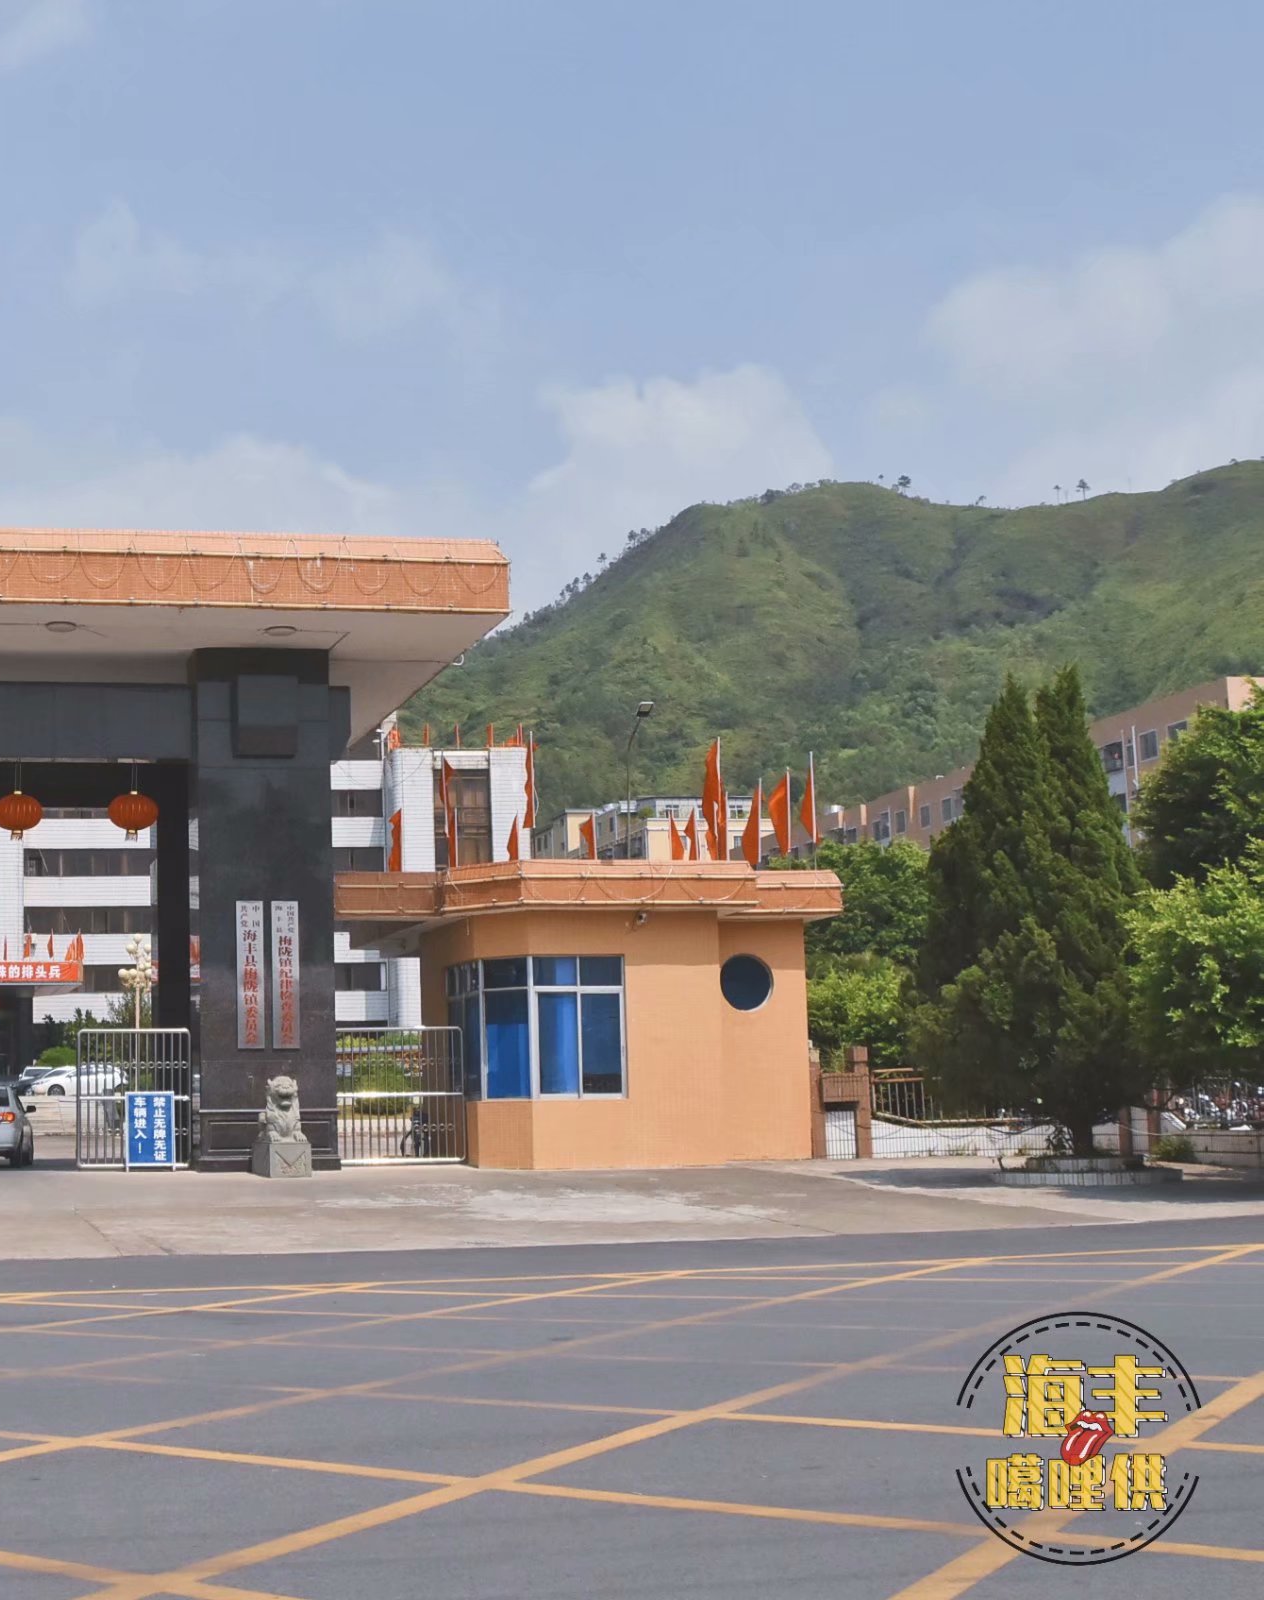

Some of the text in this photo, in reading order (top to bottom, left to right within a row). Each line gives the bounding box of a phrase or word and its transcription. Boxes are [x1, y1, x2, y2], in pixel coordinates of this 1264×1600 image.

[242, 929, 259, 1045] 海丰县梅陇镇委员会
[153, 1096, 167, 1161] 禁止无牌无证
